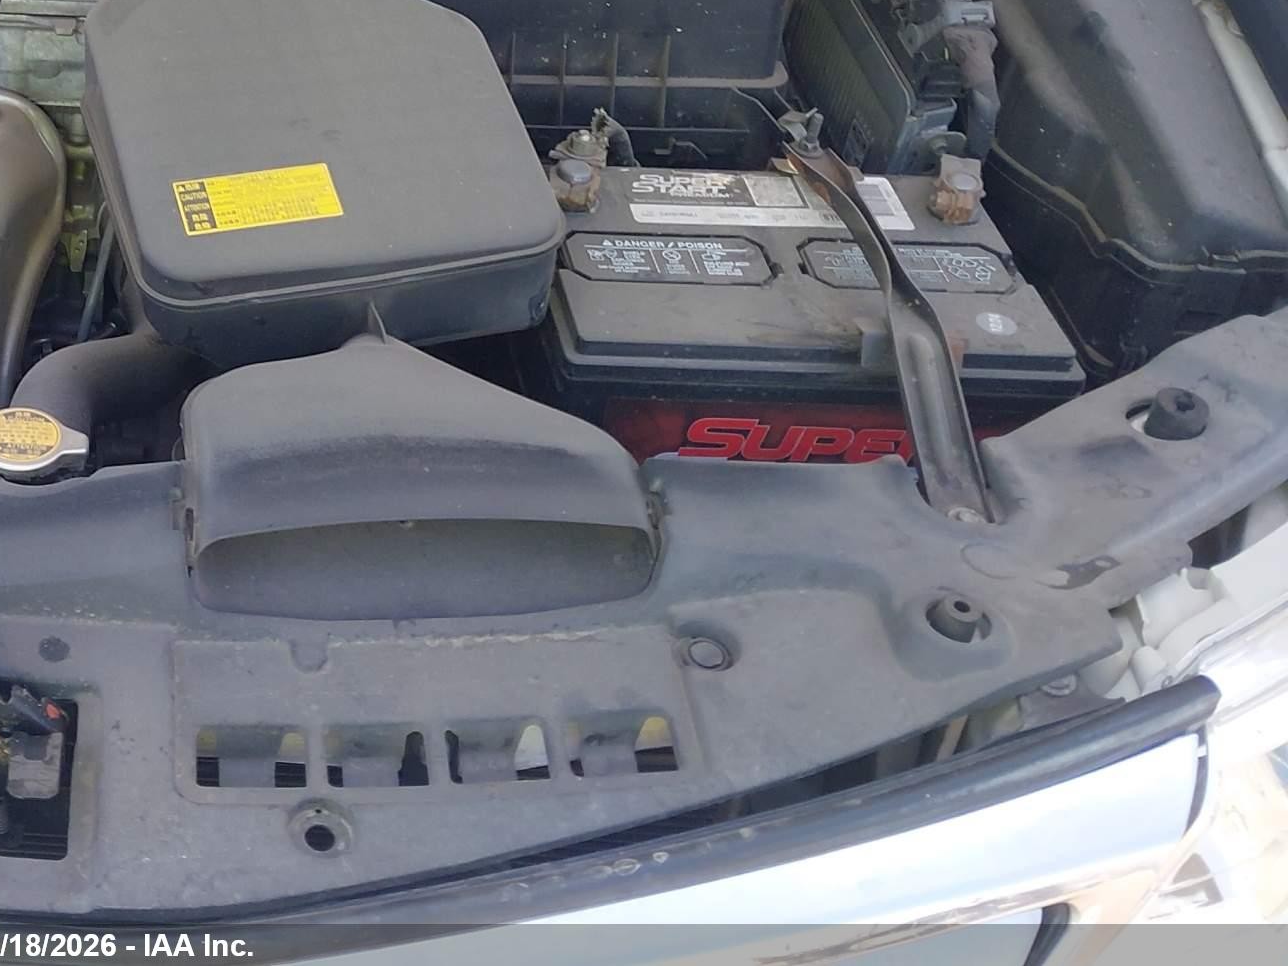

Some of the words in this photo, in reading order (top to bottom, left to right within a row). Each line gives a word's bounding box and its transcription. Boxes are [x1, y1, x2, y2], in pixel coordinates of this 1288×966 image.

[632, 182, 727, 194] START
[615, 240, 665, 248] DANGER
[677, 242, 723, 250] POISON
[678, 417, 912, 464] SUPE
